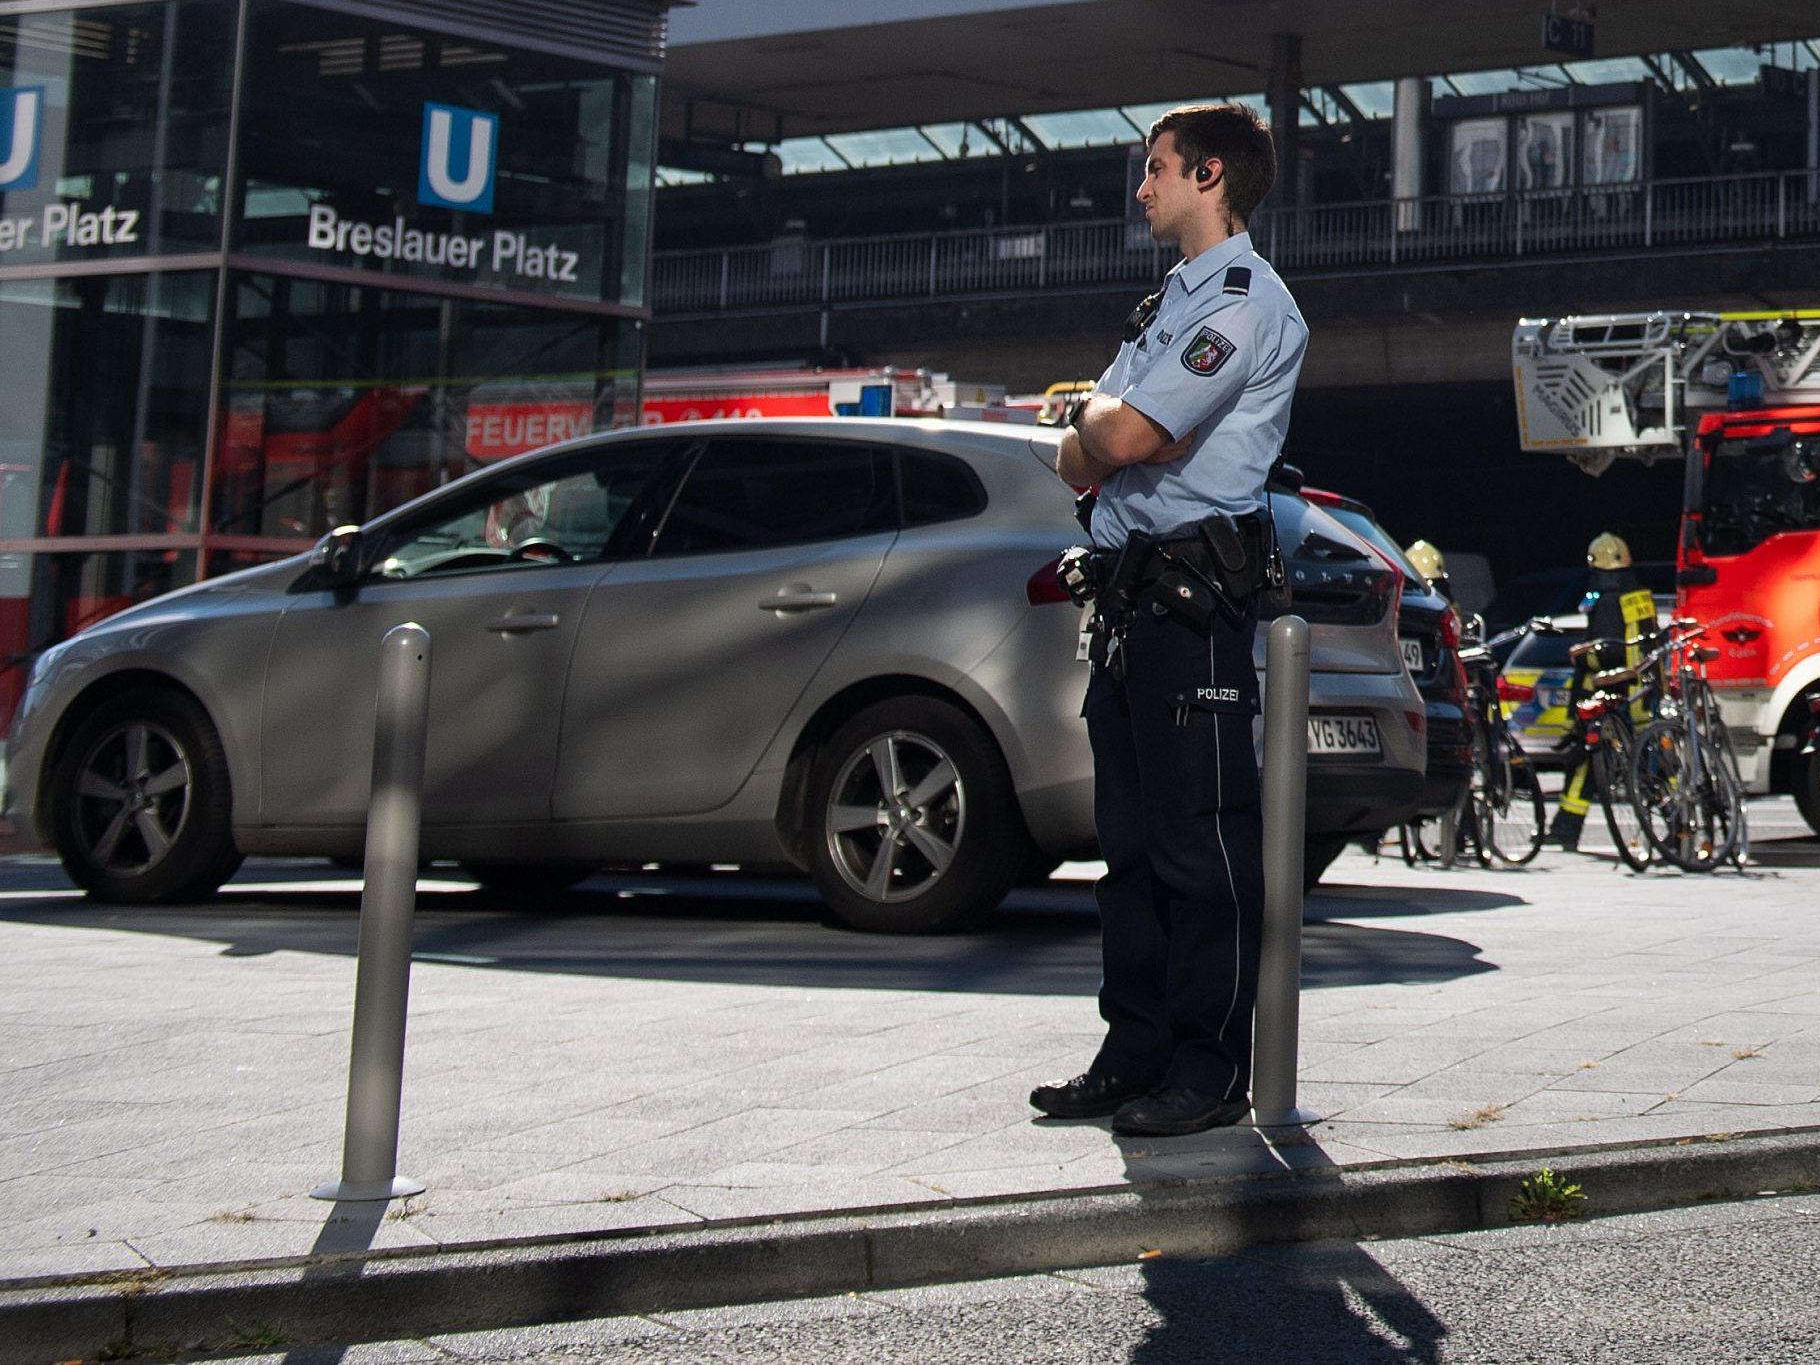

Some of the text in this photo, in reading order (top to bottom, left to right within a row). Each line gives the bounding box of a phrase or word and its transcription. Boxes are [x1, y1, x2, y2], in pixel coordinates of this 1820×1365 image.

[427, 109, 493, 203] U
[41, 203, 139, 247] Platz
[308, 204, 580, 282] Breslauer Platz
[1532, 383, 1582, 438] MAGIRUS
[1197, 688, 1239, 702] POLIZEI
[1335, 719, 1376, 748] 3643
